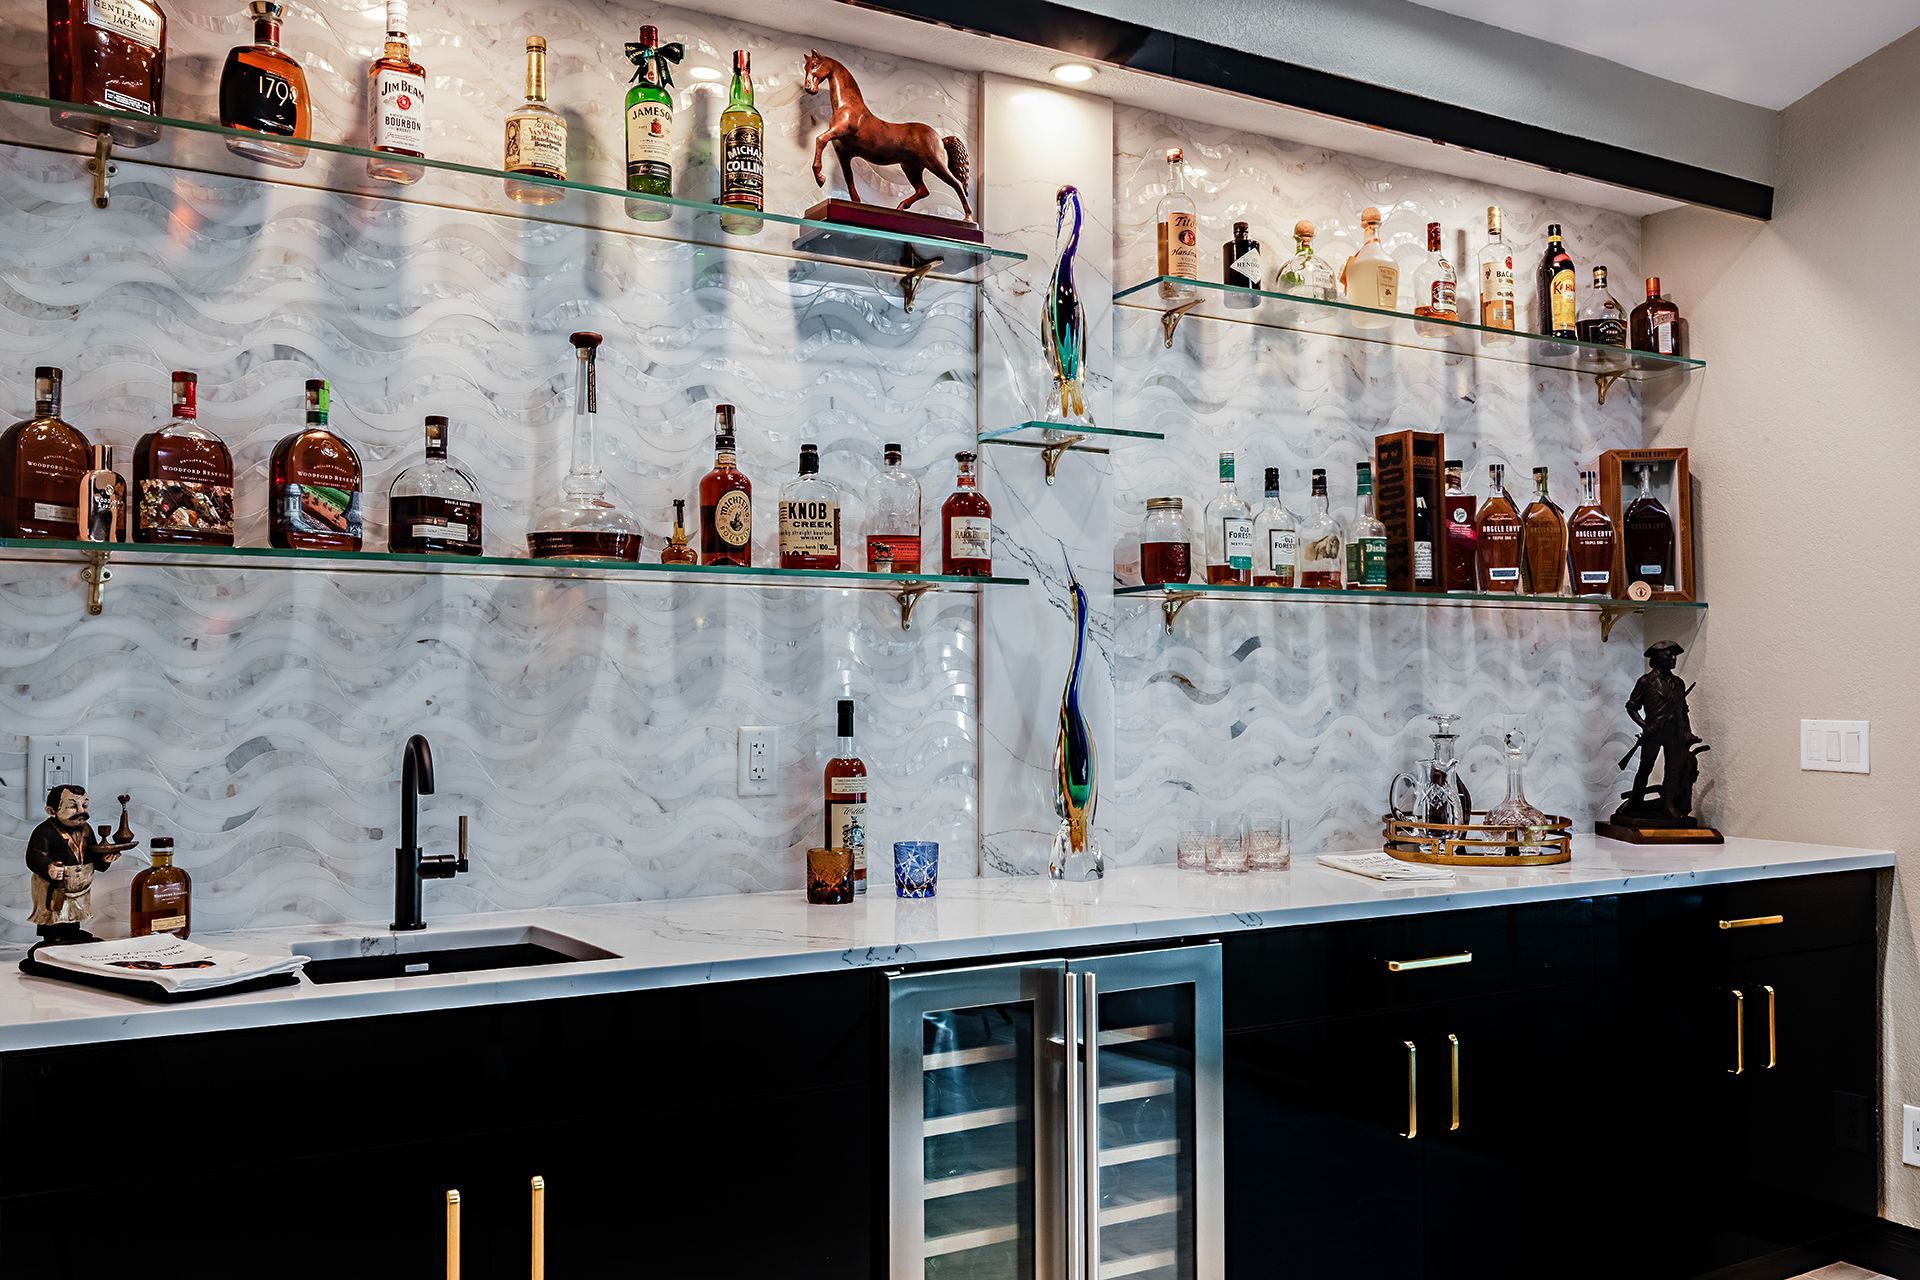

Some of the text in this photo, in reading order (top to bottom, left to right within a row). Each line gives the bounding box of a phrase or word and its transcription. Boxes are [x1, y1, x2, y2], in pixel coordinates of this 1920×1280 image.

[94, 0, 155, 27] GENTLEMAN
[112, 15, 137, 30] JACK
[381, 80, 424, 104] JIM BEAM
[385, 116, 422, 131] BOURBON
[27, 460, 64, 471] WOODFORD
[161, 465, 229, 479] WOODFORD RESERVE
[296, 470, 334, 480] WOODFORD
[788, 502, 827, 520] KNOB
[791, 530, 812, 538] straight
